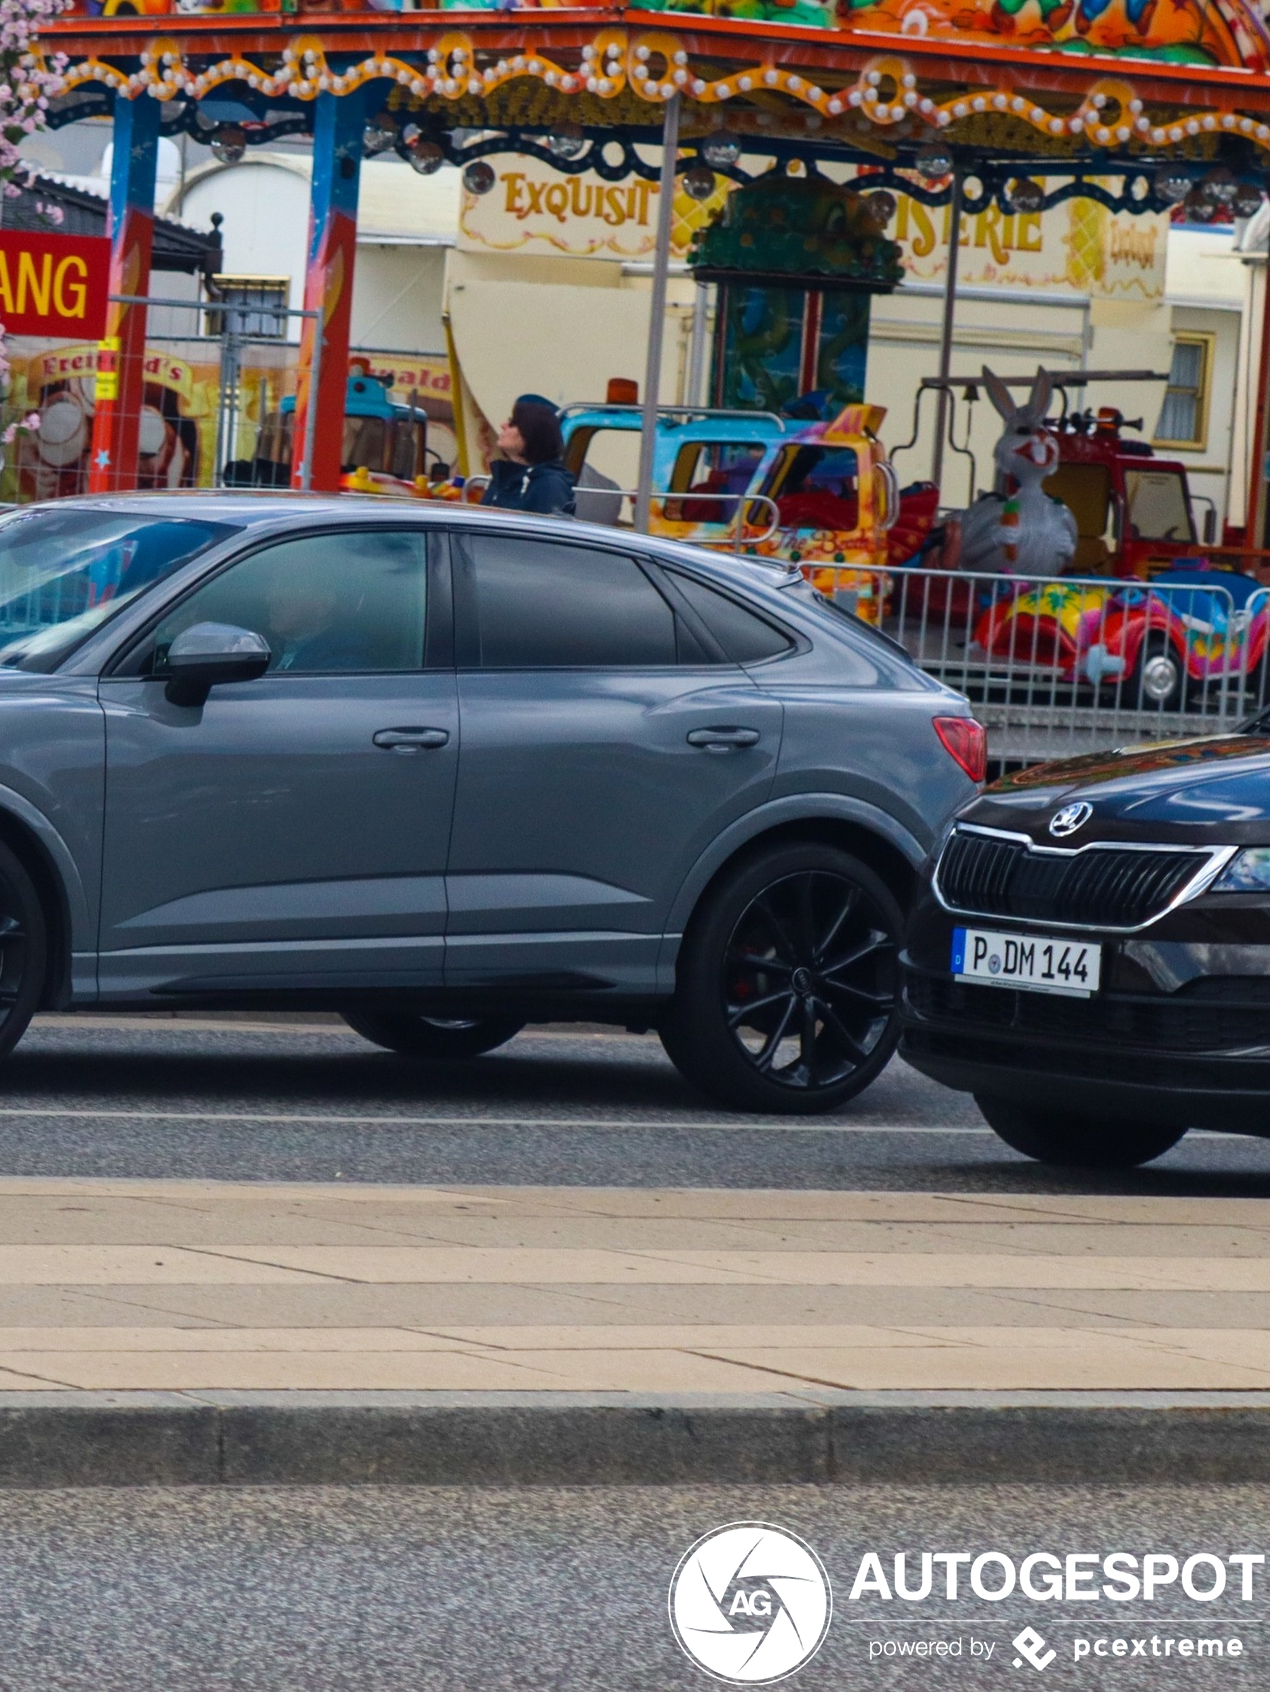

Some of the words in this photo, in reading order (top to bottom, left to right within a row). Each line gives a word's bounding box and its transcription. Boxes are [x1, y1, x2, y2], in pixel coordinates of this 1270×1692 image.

[499, 172, 660, 226] EXQUISIT
[973, 936, 988, 970] P
[1003, 940, 1036, 976] DM
[1041, 945, 1088, 983] 144
